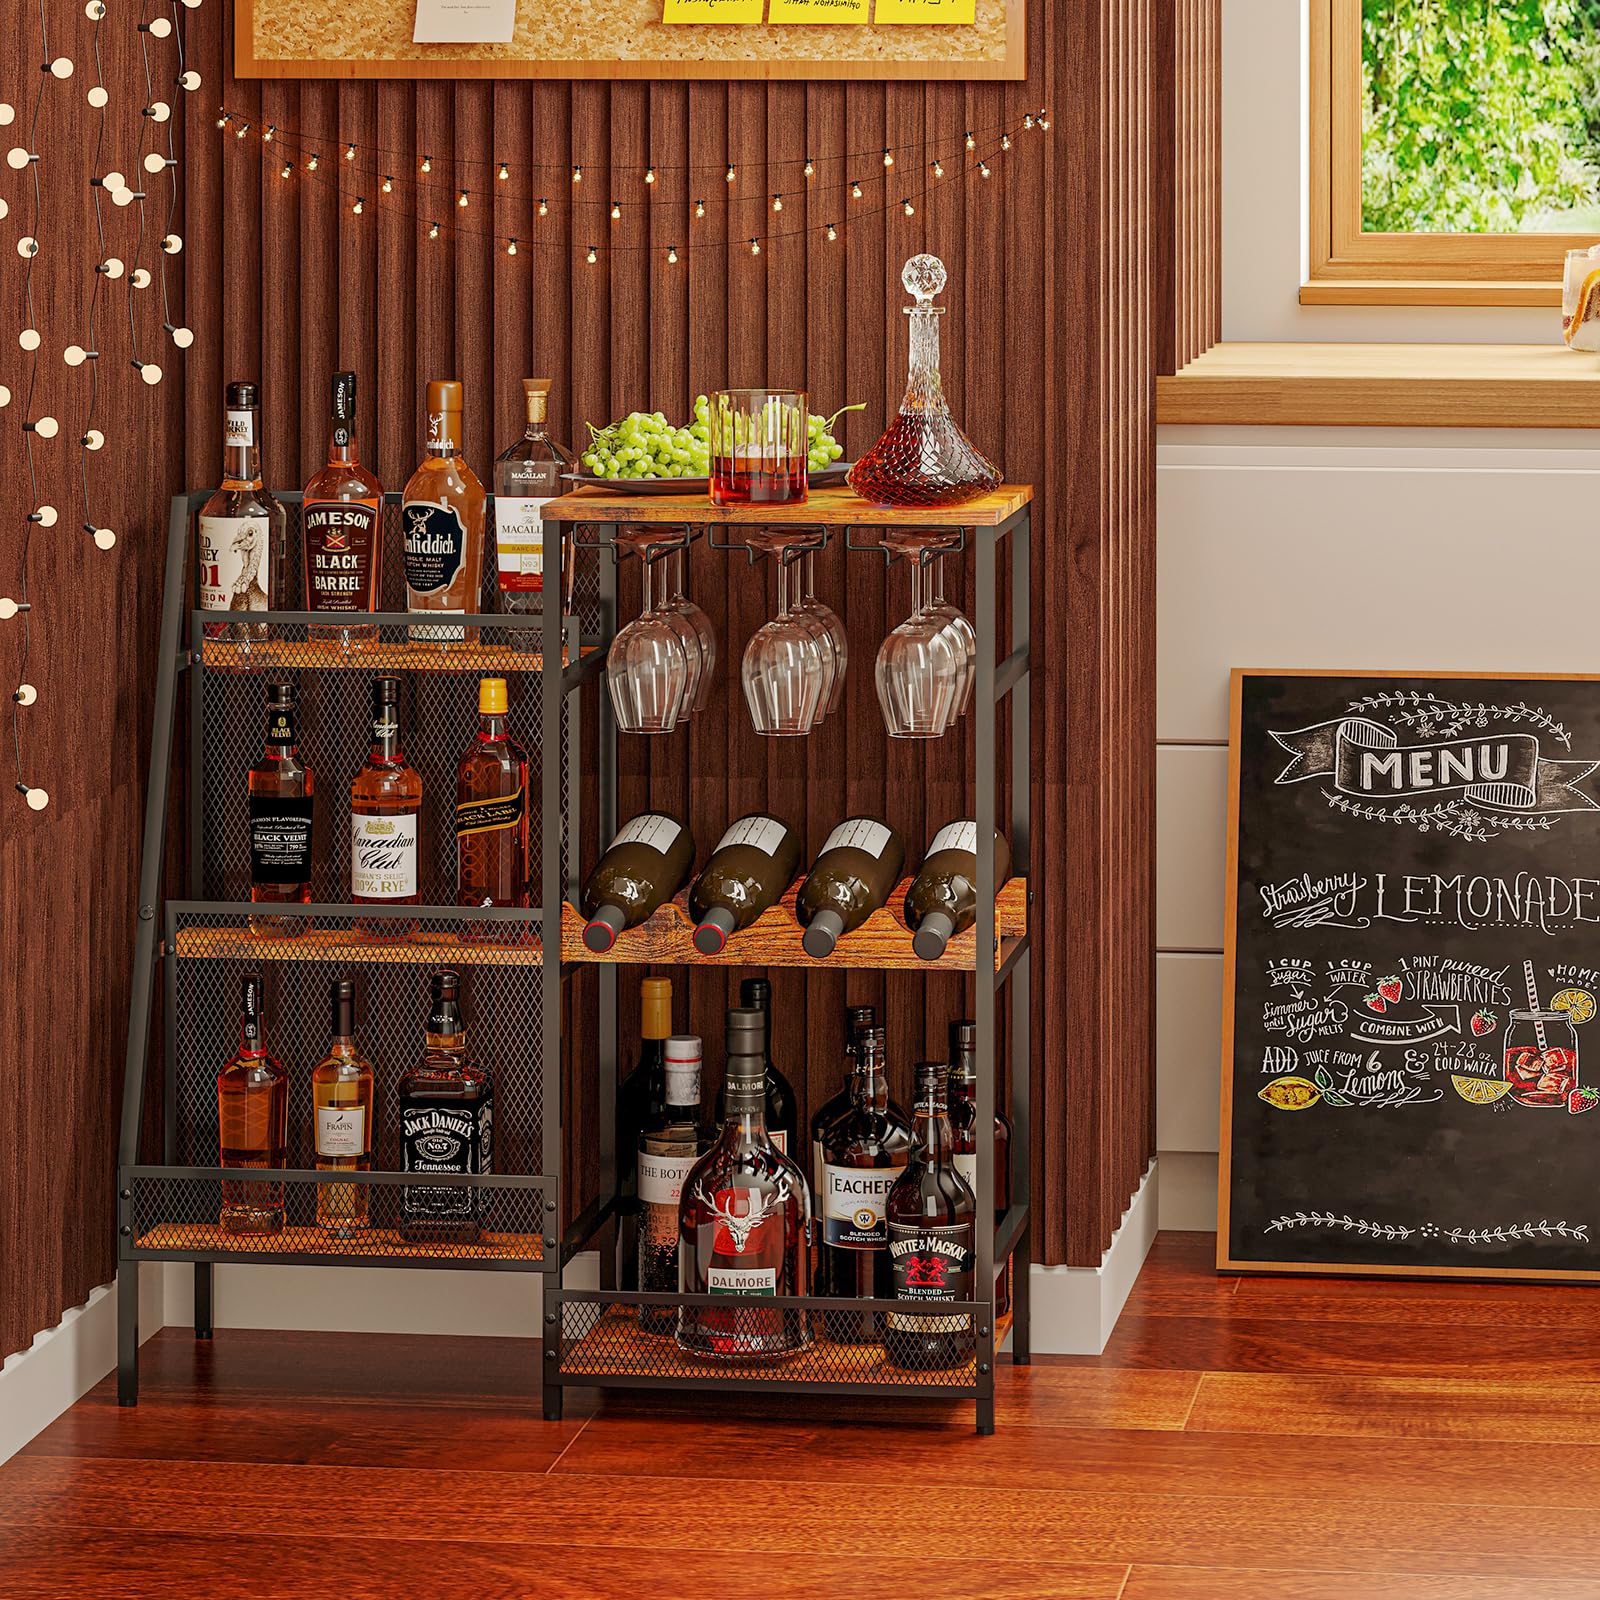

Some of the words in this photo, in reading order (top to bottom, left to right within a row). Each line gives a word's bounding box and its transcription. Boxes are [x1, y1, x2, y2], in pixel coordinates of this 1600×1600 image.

[336, 381, 345, 420] JAMESON
[511, 472, 547, 480] MACALLAN
[307, 511, 370, 530] JAMESON
[502, 524, 542, 535] MACALL
[316, 554, 358, 569] BLACK
[315, 575, 360, 591] BARREL
[1361, 744, 1509, 790] MENU
[254, 833, 281, 841] BLACK
[283, 833, 307, 841] VELVET
[353, 826, 415, 848] Canadian
[359, 848, 404, 870] Club
[381, 880, 404, 892] RYE
[1259, 872, 1367, 917] Strawberry
[1373, 871, 1600, 936] LEMONADE
[1280, 958, 1312, 969] CUP
[1340, 959, 1372, 971] CUP
[1398, 957, 1411, 972] 1
[1412, 955, 1439, 969] PINT
[1440, 958, 1511, 987] pureed
[1270, 970, 1312, 984] Sugar
[1330, 971, 1367, 985] WATER
[1557, 964, 1600, 983] HOME
[1405, 969, 1513, 1006] STRAWBERRIES
[1555, 977, 1592, 989] MADE
[247, 982, 255, 1017] JAMESON
[1262, 997, 1319, 1020] Simmer
[1263, 1015, 1284, 1029] until
[1285, 1000, 1349, 1043] Sugar
[1318, 1023, 1344, 1036] MELTS
[1359, 1020, 1413, 1037] COMBINE
[1415, 1017, 1445, 1034] WITH
[1260, 1046, 1300, 1073] ADD
[1303, 1049, 1331, 1066] JUICE
[1333, 1050, 1363, 1068] FROM
[1365, 1050, 1383, 1073] 6
[1431, 1041, 1478, 1059] 24-28
[1478, 1052, 1494, 1062] oz.
[1404, 1049, 1430, 1074] &
[1434, 1057, 1461, 1071] COLD
[1464, 1059, 1498, 1077] WATER
[1336, 1068, 1406, 1096] Lemons
[326, 1121, 353, 1130] FRAPIN
[403, 1116, 431, 1136] JACK
[431, 1111, 475, 1138] DANIEL'S
[427, 1142, 449, 1150] No.7
[414, 1159, 461, 1172] Tennessee
[640, 1164, 658, 1178] THE
[671, 1189, 680, 1198] 22
[839, 1234, 866, 1242] SCOTCH
[888, 1239, 919, 1259] WHYTE
[926, 1236, 968, 1262] MACKAY
[712, 1276, 771, 1287] DALMORE
[908, 1287, 943, 1296] BLENDED
